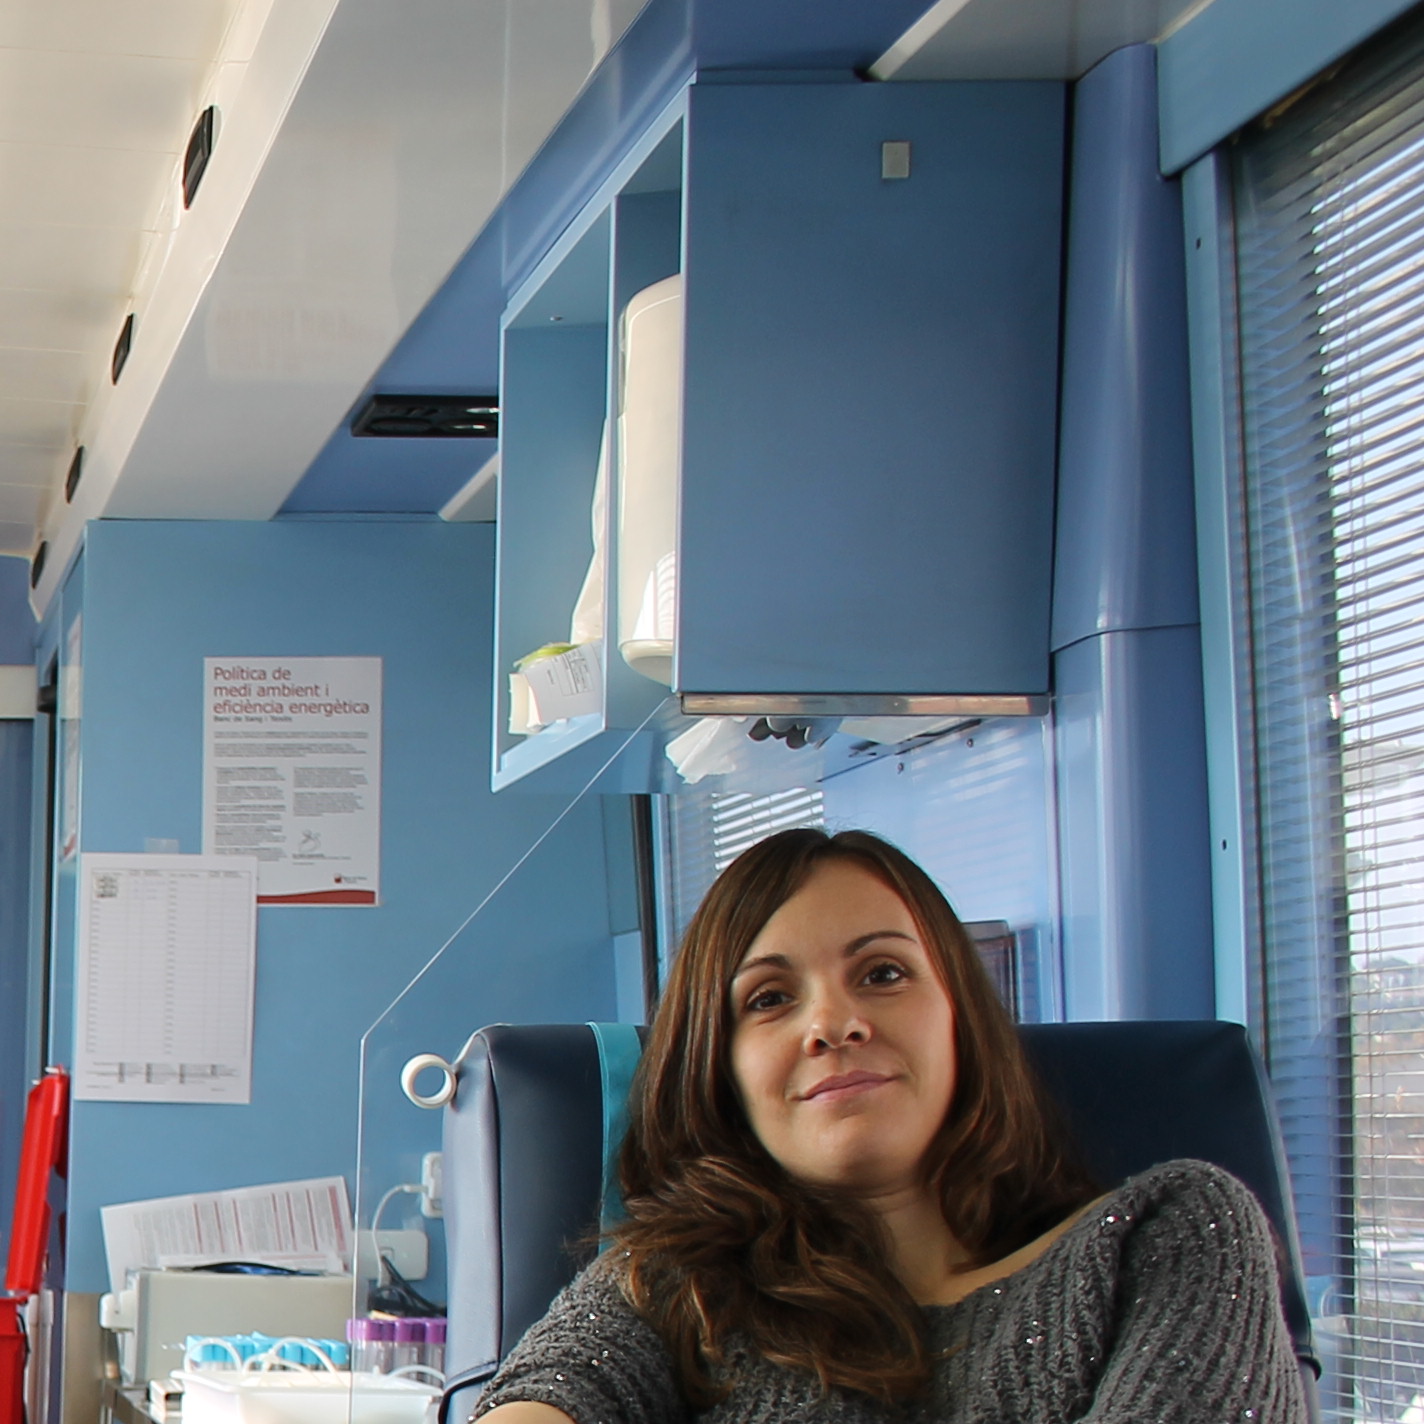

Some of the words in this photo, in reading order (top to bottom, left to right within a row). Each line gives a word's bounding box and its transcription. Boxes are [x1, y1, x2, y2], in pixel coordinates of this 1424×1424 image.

[214, 666, 267, 681] Política
[271, 666, 292, 681] de
[213, 683, 252, 698] medi
[256, 683, 321, 698] ambient
[324, 684, 330, 698] i
[213, 699, 284, 715] eficiència
[289, 699, 370, 717] energètica
